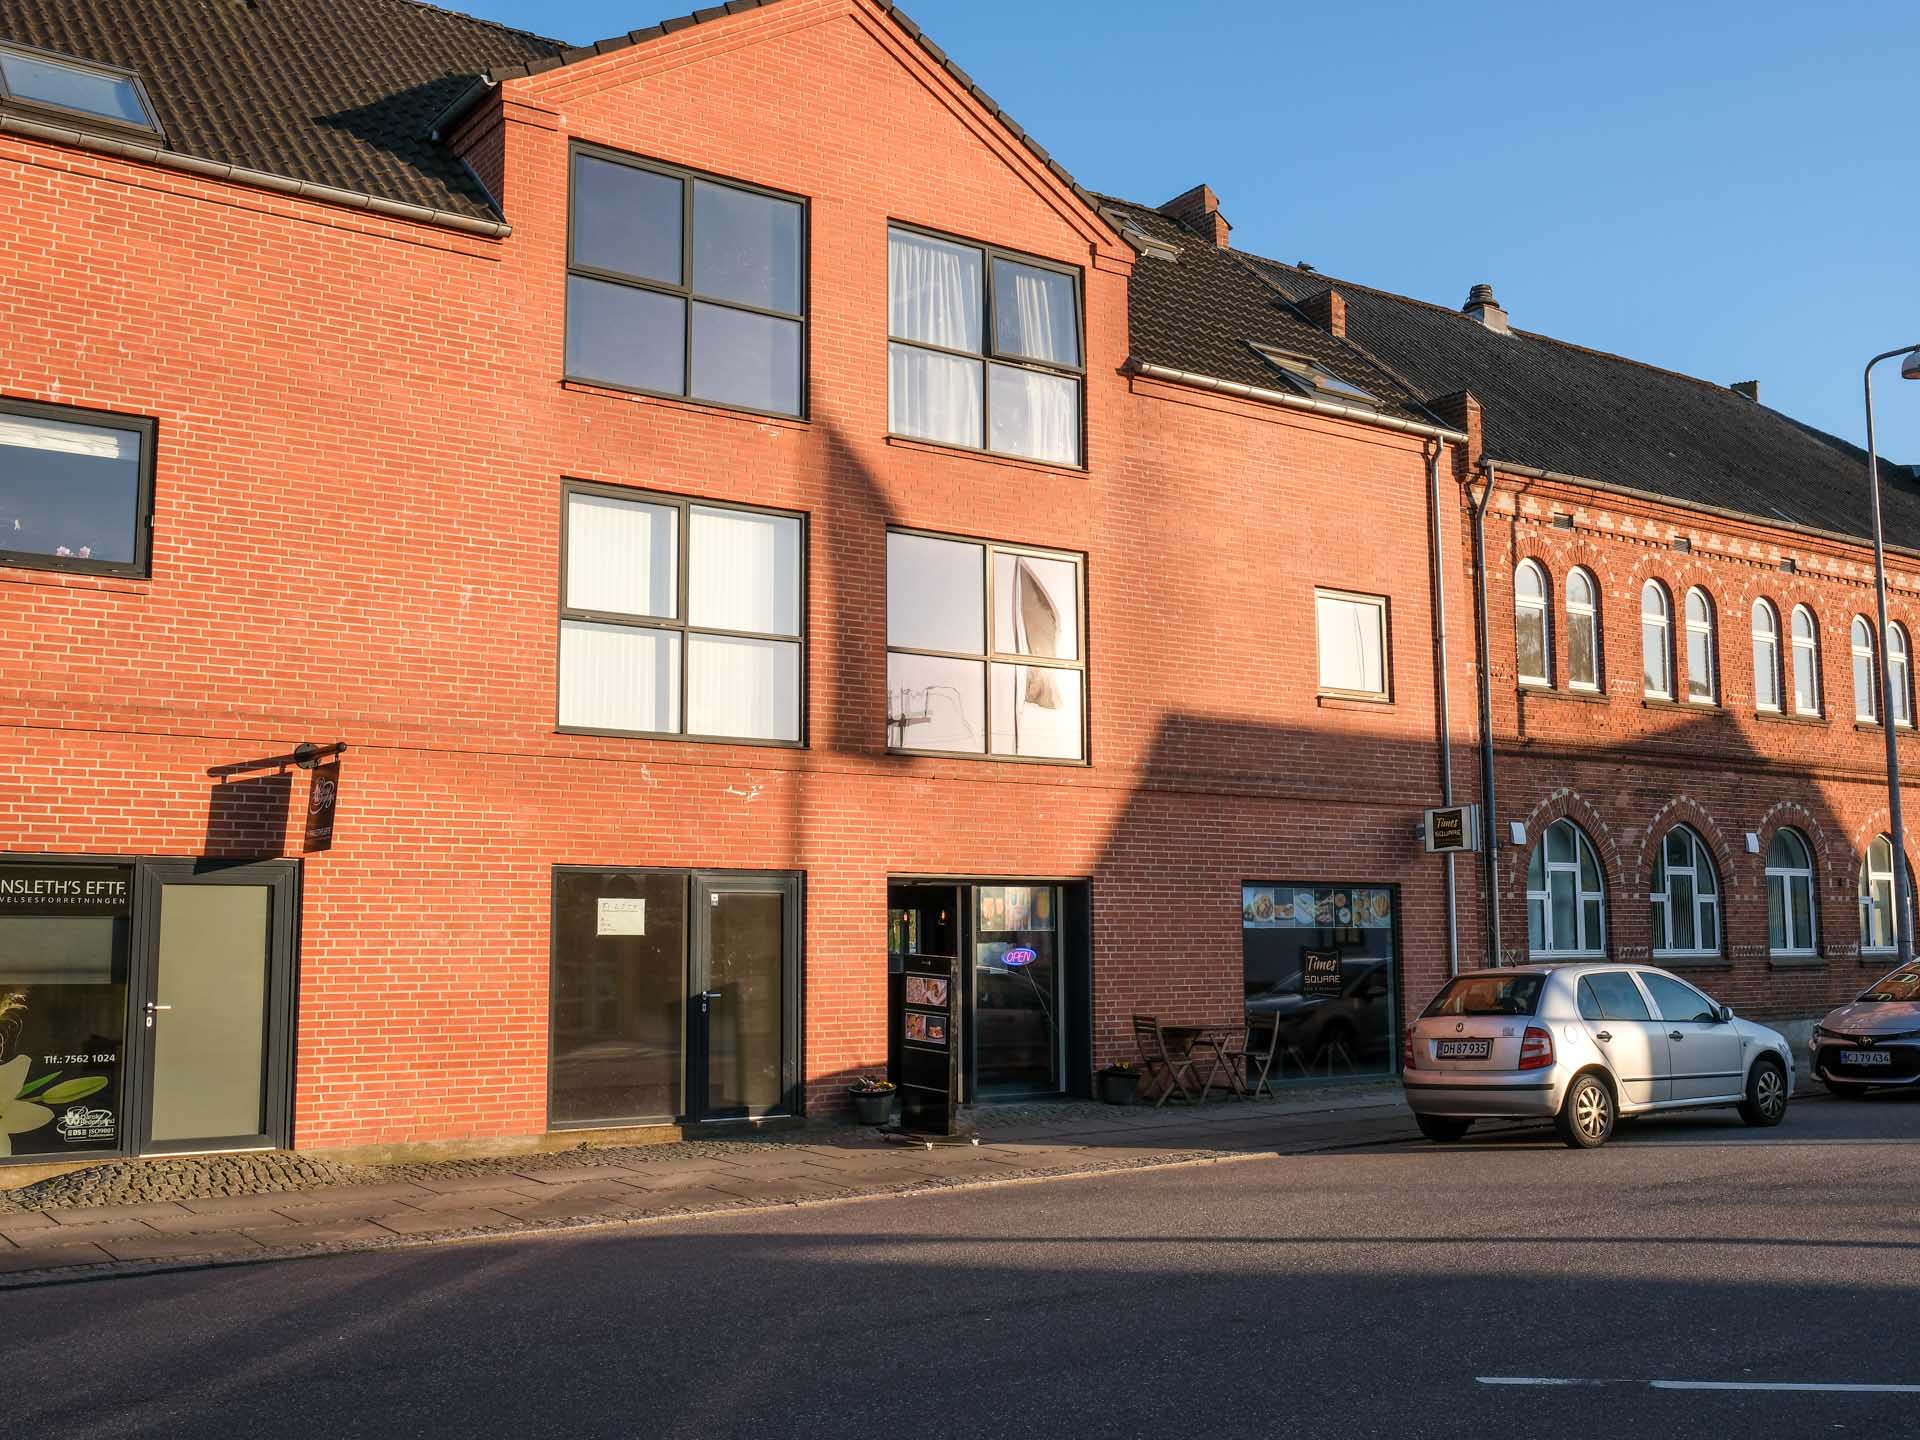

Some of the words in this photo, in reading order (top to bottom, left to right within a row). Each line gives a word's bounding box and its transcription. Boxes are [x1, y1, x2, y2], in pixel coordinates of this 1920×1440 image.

[86, 880, 127, 896] EFTF.
[1006, 951, 1032, 963] OPEN
[1307, 955, 1337, 972] Times
[1304, 975, 1341, 984] SQUARE
[1443, 1043, 1455, 1055] DH
[1456, 1043, 1468, 1055] 87
[1469, 1043, 1486, 1055] 935
[43, 1055, 63, 1065] Tlf.:
[64, 1054, 89, 1064] 7562
[91, 1053, 116, 1063] 1024
